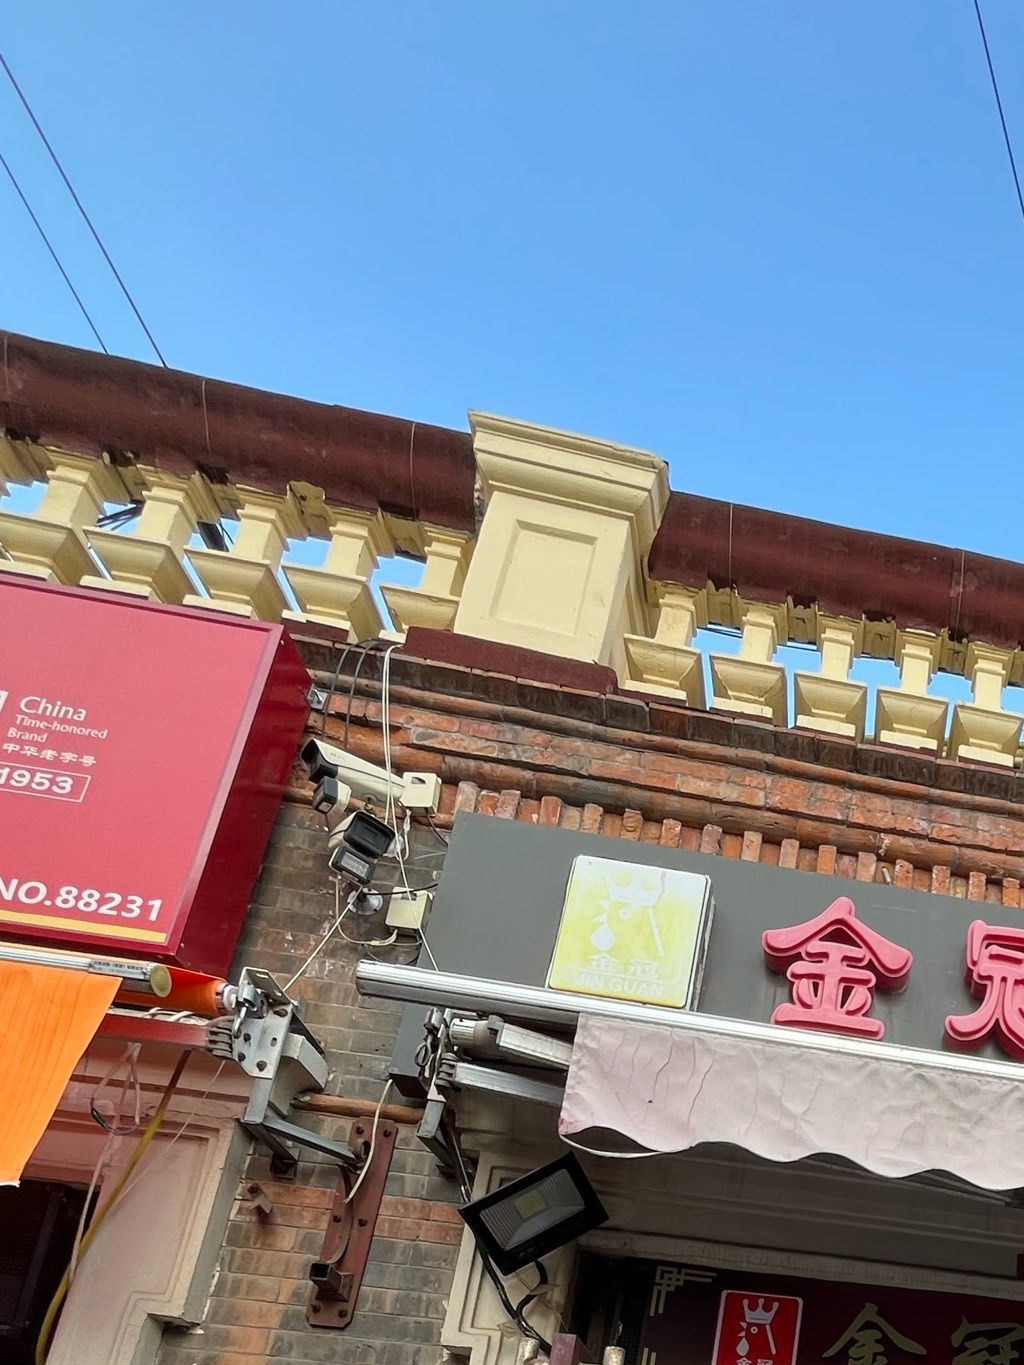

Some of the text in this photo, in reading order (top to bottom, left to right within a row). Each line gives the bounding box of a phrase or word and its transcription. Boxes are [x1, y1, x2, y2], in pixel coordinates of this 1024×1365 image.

[19, 695, 88, 722] China
[7, 726, 48, 743] Brand
[15, 714, 109, 740] Time-honored
[2, 742, 97, 767] 中华老字号
